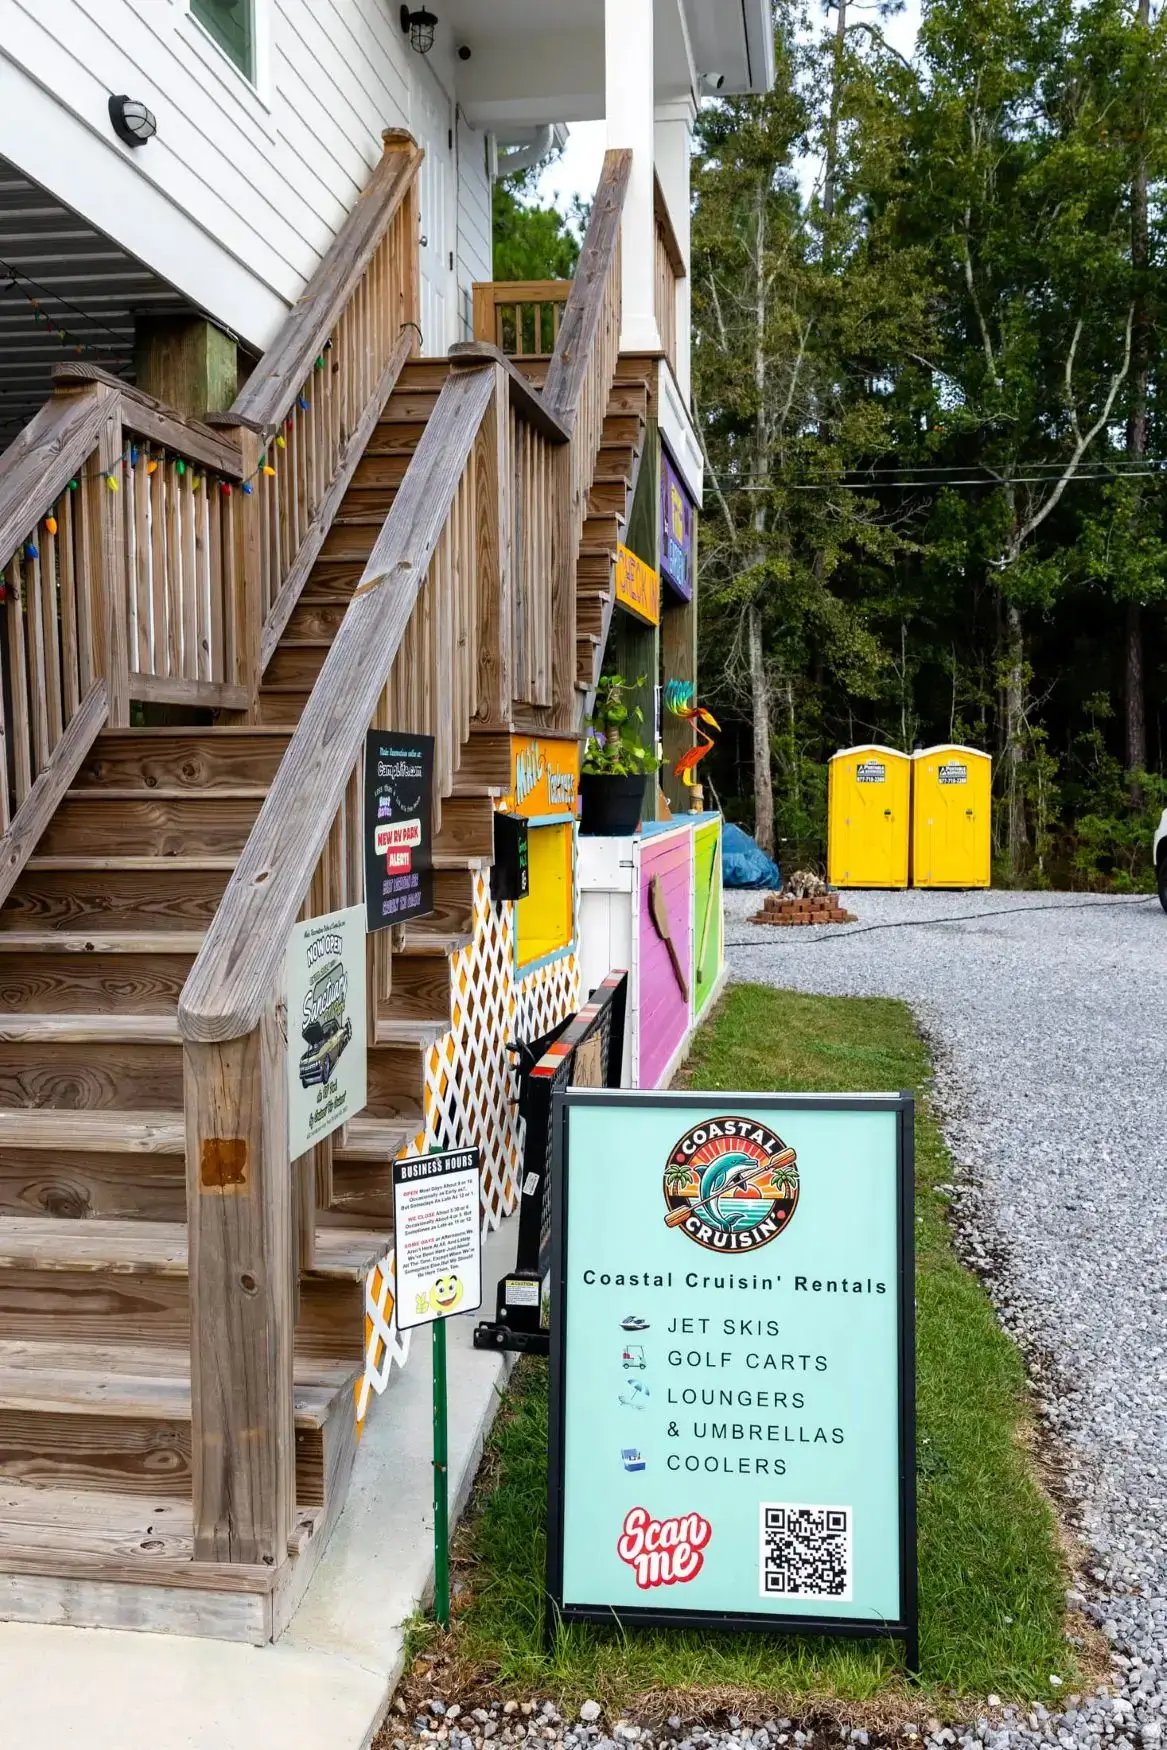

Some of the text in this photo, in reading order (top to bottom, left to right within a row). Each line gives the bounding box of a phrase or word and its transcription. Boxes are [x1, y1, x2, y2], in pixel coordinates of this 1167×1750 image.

[377, 760, 421, 779] CampLife.com
[378, 826, 418, 846] NEW RV PARK
[389, 850, 409, 868] ALERT!
[307, 929, 342, 967] NOW OPEN
[302, 970, 348, 1030] Sanctuary
[682, 1120, 778, 1156] COASTAL
[401, 1154, 472, 1178] BUSINESS HOURS
[409, 1192, 437, 1202] Occasionally
[405, 1219, 434, 1229] Occasionally
[686, 1212, 779, 1249] CRUISIN'
[583, 1270, 887, 1295] Coastal Cruisin' Rentals
[668, 1318, 779, 1336] JET SKIS
[668, 1351, 828, 1371] GOLF CARTS
[667, 1388, 804, 1408] LOUNGERS
[667, 1421, 845, 1444] & UMBRELLAS
[667, 1455, 786, 1475] COOLERS
[619, 1507, 709, 1560] Scan
[634, 1544, 701, 1587] me
